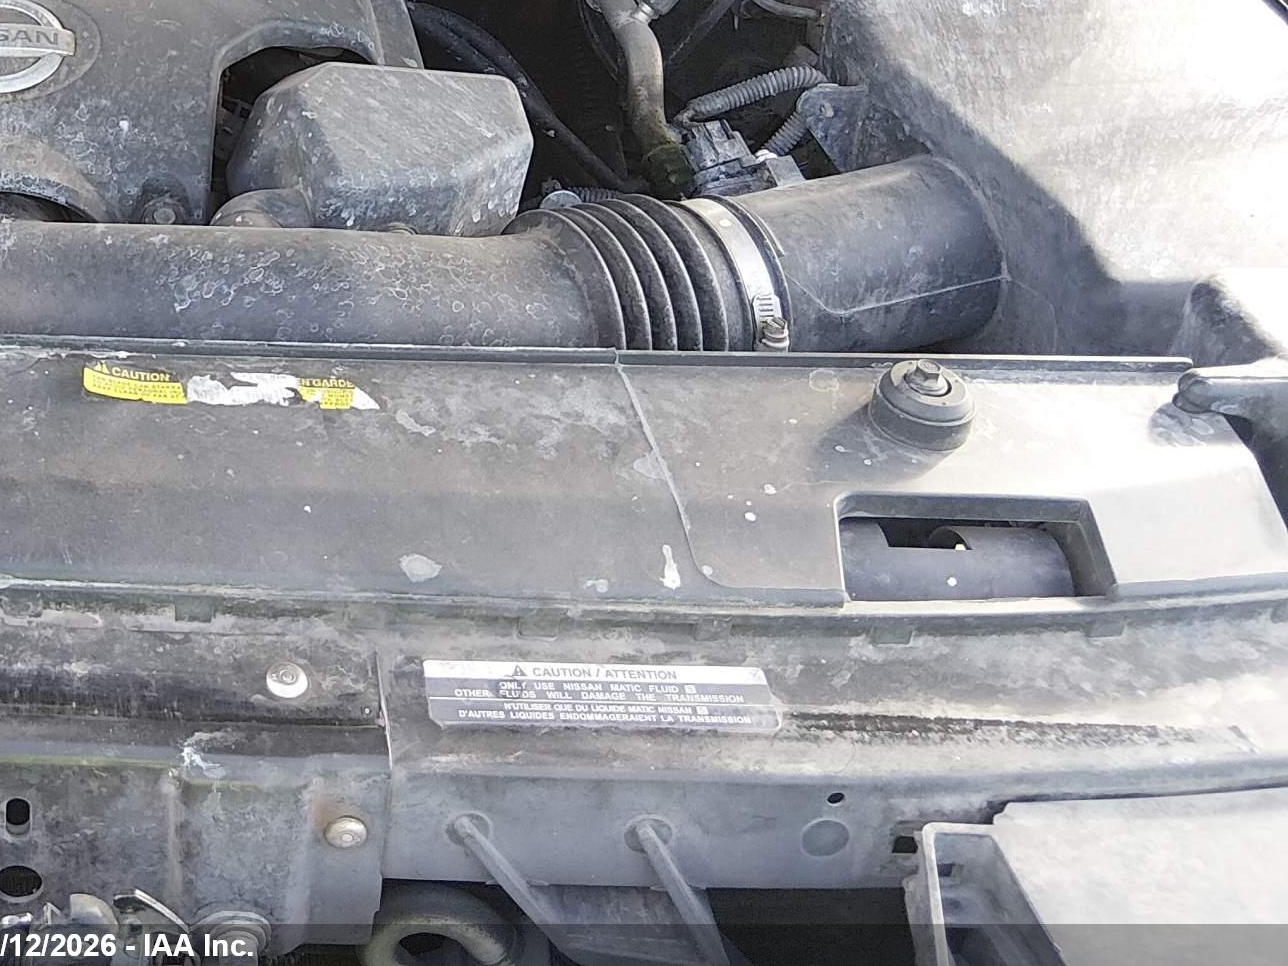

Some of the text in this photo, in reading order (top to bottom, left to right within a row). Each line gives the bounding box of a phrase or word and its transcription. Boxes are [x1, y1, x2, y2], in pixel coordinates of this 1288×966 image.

[111, 367, 171, 381] CAUTION
[312, 378, 355, 388] GARDE
[533, 668, 592, 677] CAUTION
[605, 669, 677, 680] ATTENTION
[499, 682, 526, 690] ONLY
[534, 682, 556, 690] USE
[563, 683, 603, 691] NISSAN
[610, 684, 641, 692] MATIC
[648, 684, 679, 693] FLUID
[454, 689, 491, 698] OTHER
[546, 691, 573, 700] WILL
[581, 692, 626, 700] DAMAGE
[635, 693, 657, 701] THE
[666, 694, 744, 703] TRANSMISSION
[553, 704, 573, 712] QUE
[575, 704, 589, 712] DU
[591, 705, 625, 714] LIQUIDE
[628, 706, 655, 714] MATIC
[657, 706, 692, 715] NISSAN
[459, 710, 505, 719] D'AUTRES
[510, 711, 555, 720] LIQUIDES
[559, 713, 657, 722] ENDOMMAGERAIENT
[678, 715, 752, 724] TRANSMISSION
